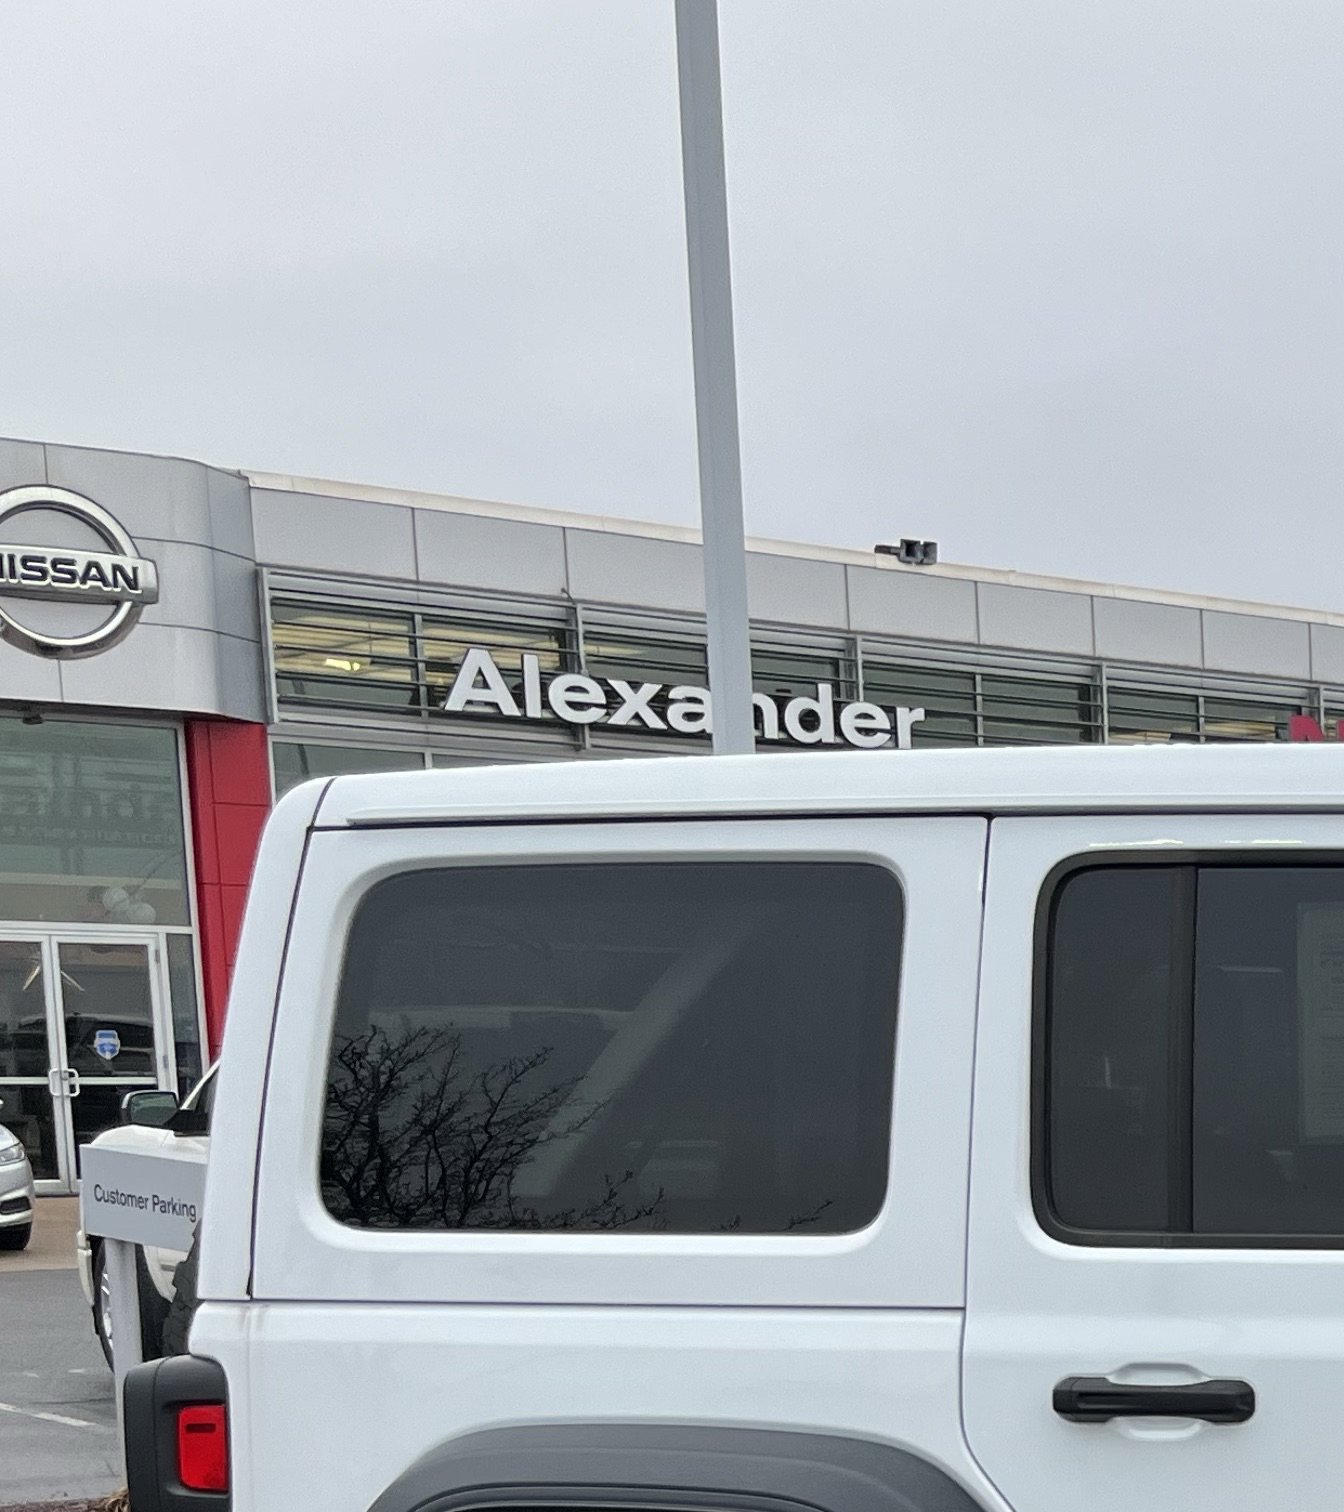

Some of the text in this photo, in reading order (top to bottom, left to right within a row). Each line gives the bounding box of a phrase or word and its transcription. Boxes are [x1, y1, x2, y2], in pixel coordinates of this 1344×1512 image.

[0, 553, 140, 592] ISSAN
[93, 1183, 198, 1224] Customer Parking
